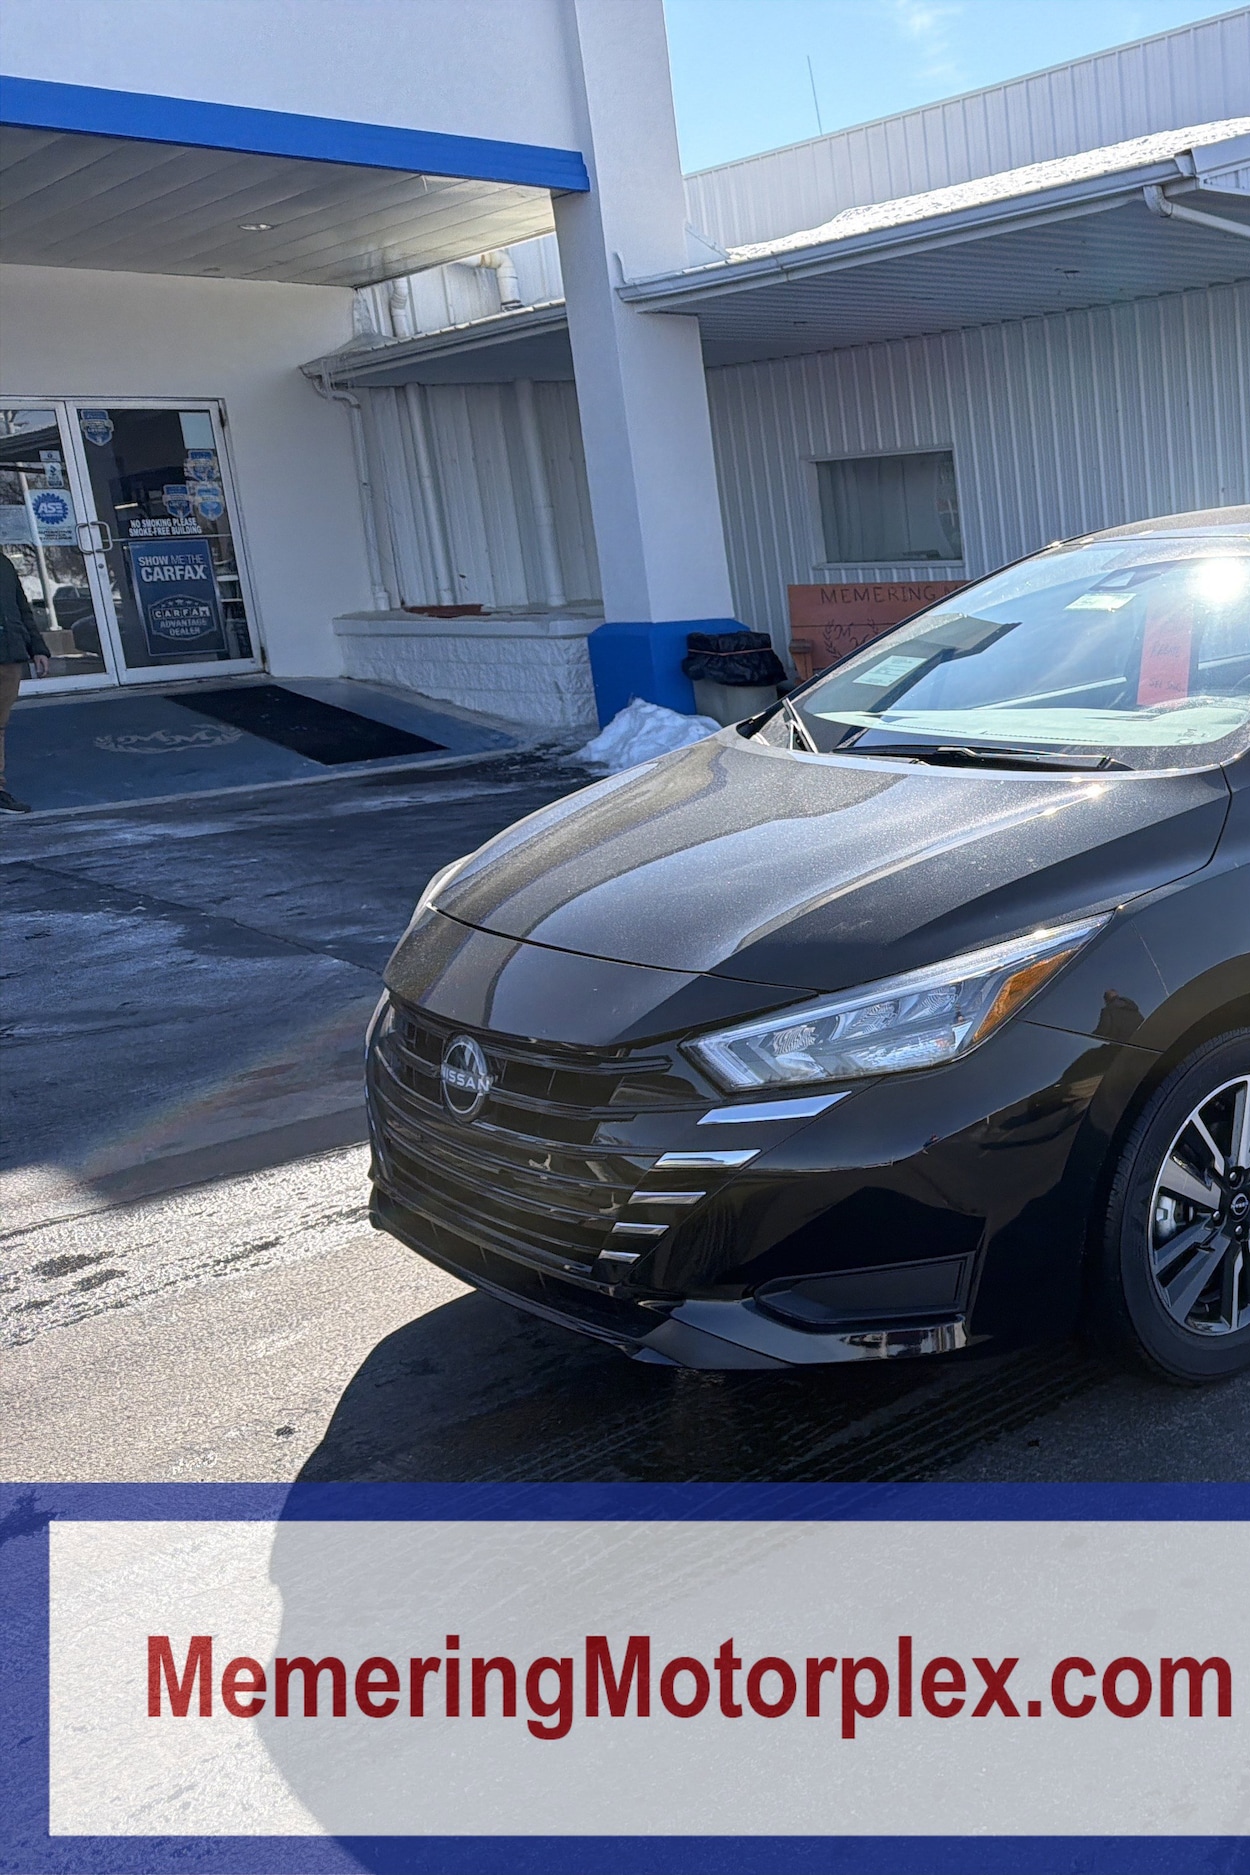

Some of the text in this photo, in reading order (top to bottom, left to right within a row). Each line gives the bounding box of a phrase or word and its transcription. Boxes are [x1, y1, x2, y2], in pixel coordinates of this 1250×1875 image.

[38, 502, 63, 514] ASE
[130, 516, 197, 528] NO SMOKING PLEASE
[129, 525, 202, 537] SMOKE-FREE BUILDING
[138, 553, 204, 567] SHOW ME THE
[141, 564, 208, 582] CARFAX
[820, 585, 936, 604] MEMERING
[155, 606, 210, 618] CARFAX
[160, 618, 208, 629] ADVANTAGE
[169, 626, 200, 637] DEALER
[441, 1063, 490, 1092] NISSAN
